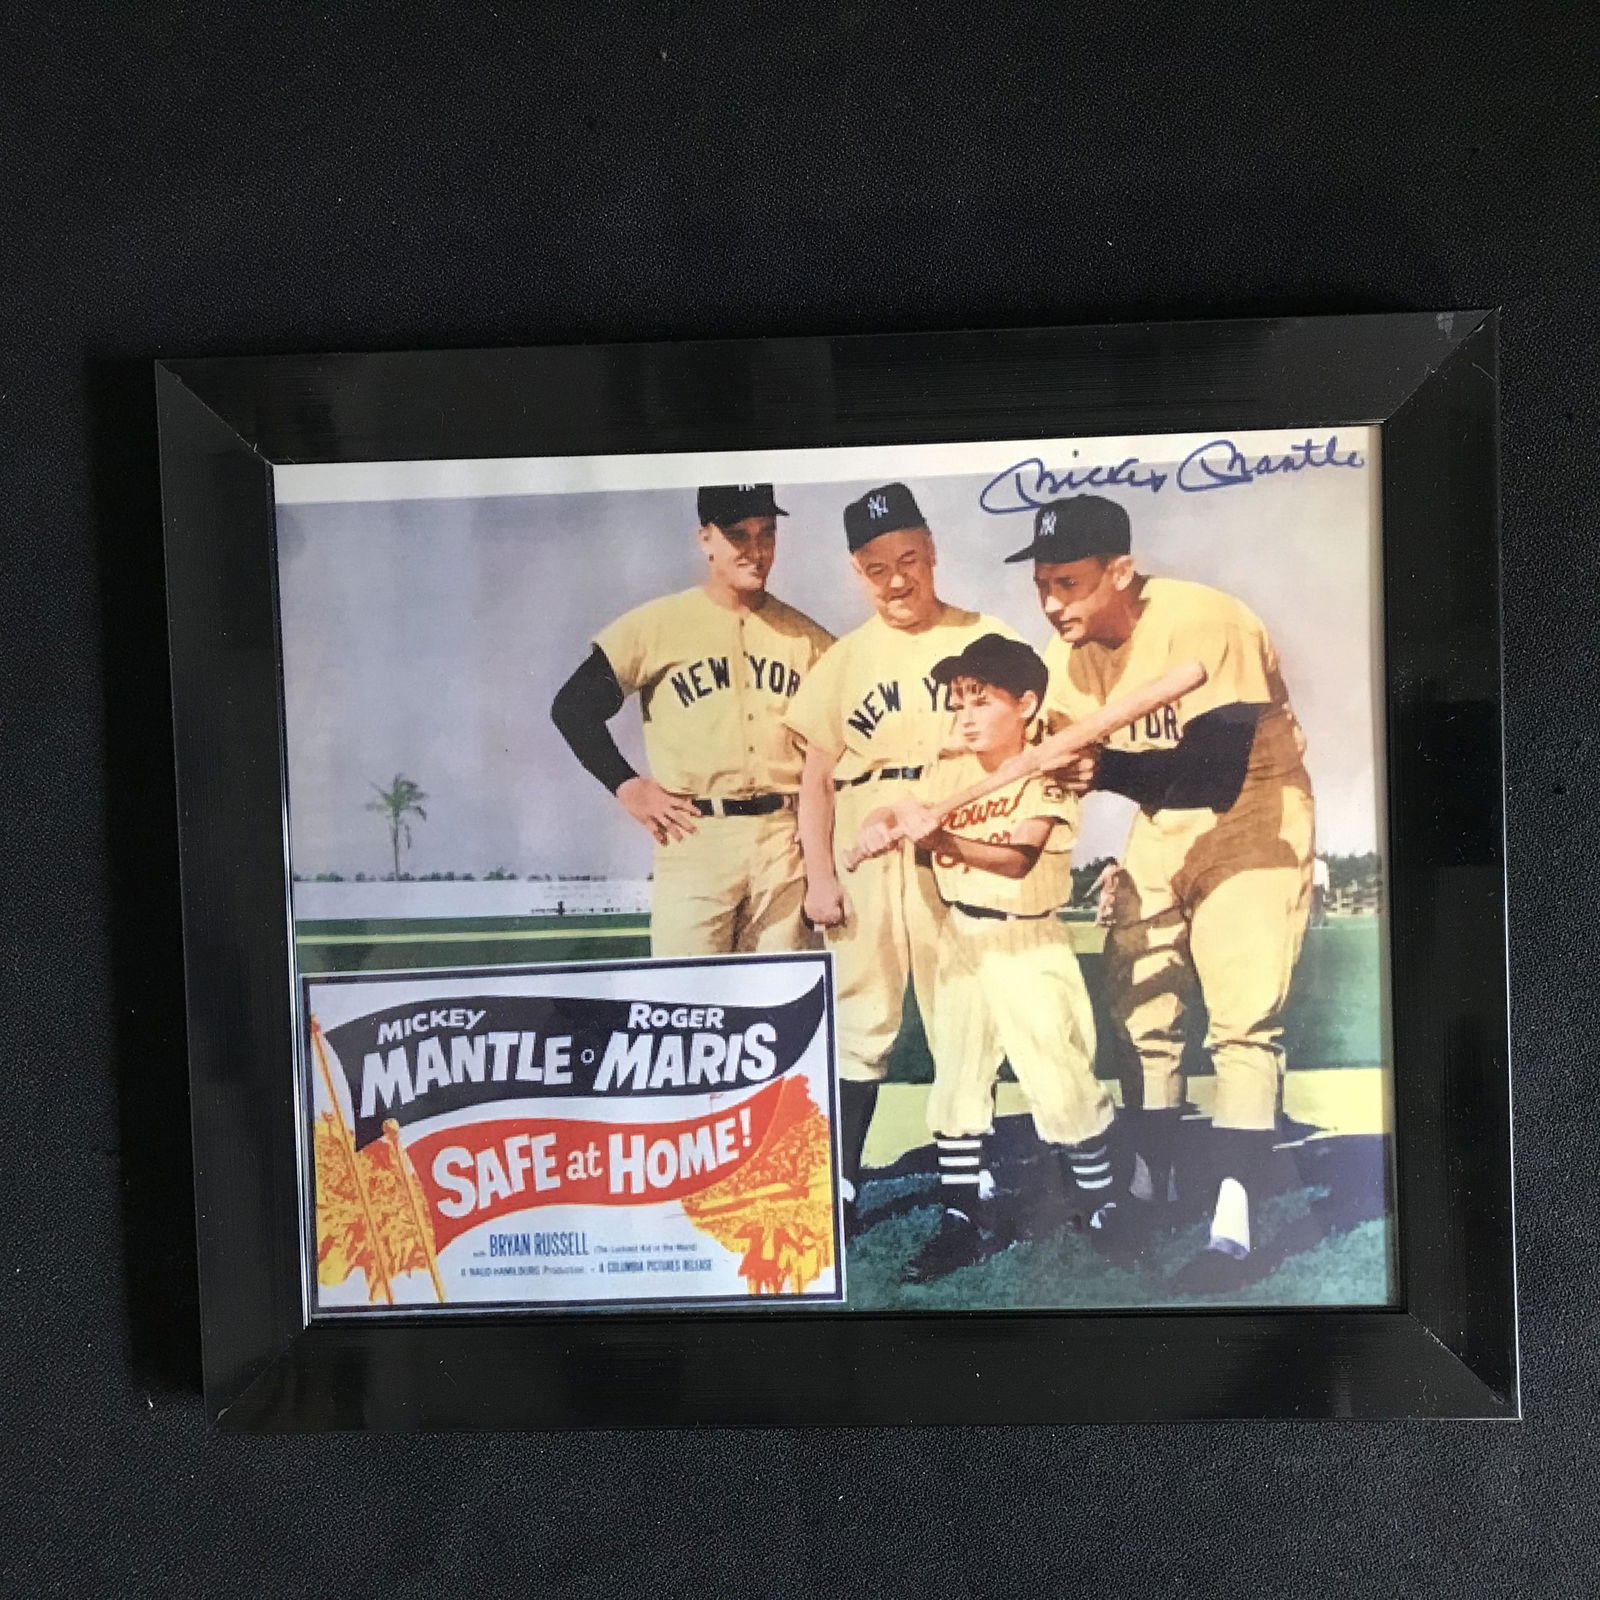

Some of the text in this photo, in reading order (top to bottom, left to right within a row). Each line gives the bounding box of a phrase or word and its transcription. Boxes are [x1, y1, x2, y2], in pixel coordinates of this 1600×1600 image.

[1176, 435, 1365, 492] Mantle
[671, 655, 801, 708] NEW YOR
[847, 680, 901, 740] NEW
[376, 1009, 487, 1045] MICKEY
[627, 1002, 725, 1030] ROGER
[360, 1022, 777, 1119] MANTLE MARIS
[432, 1107, 752, 1219] SAFE at HOME!
[490, 1232, 531, 1257] BRYAN
[534, 1231, 589, 1256] RUSSELL
